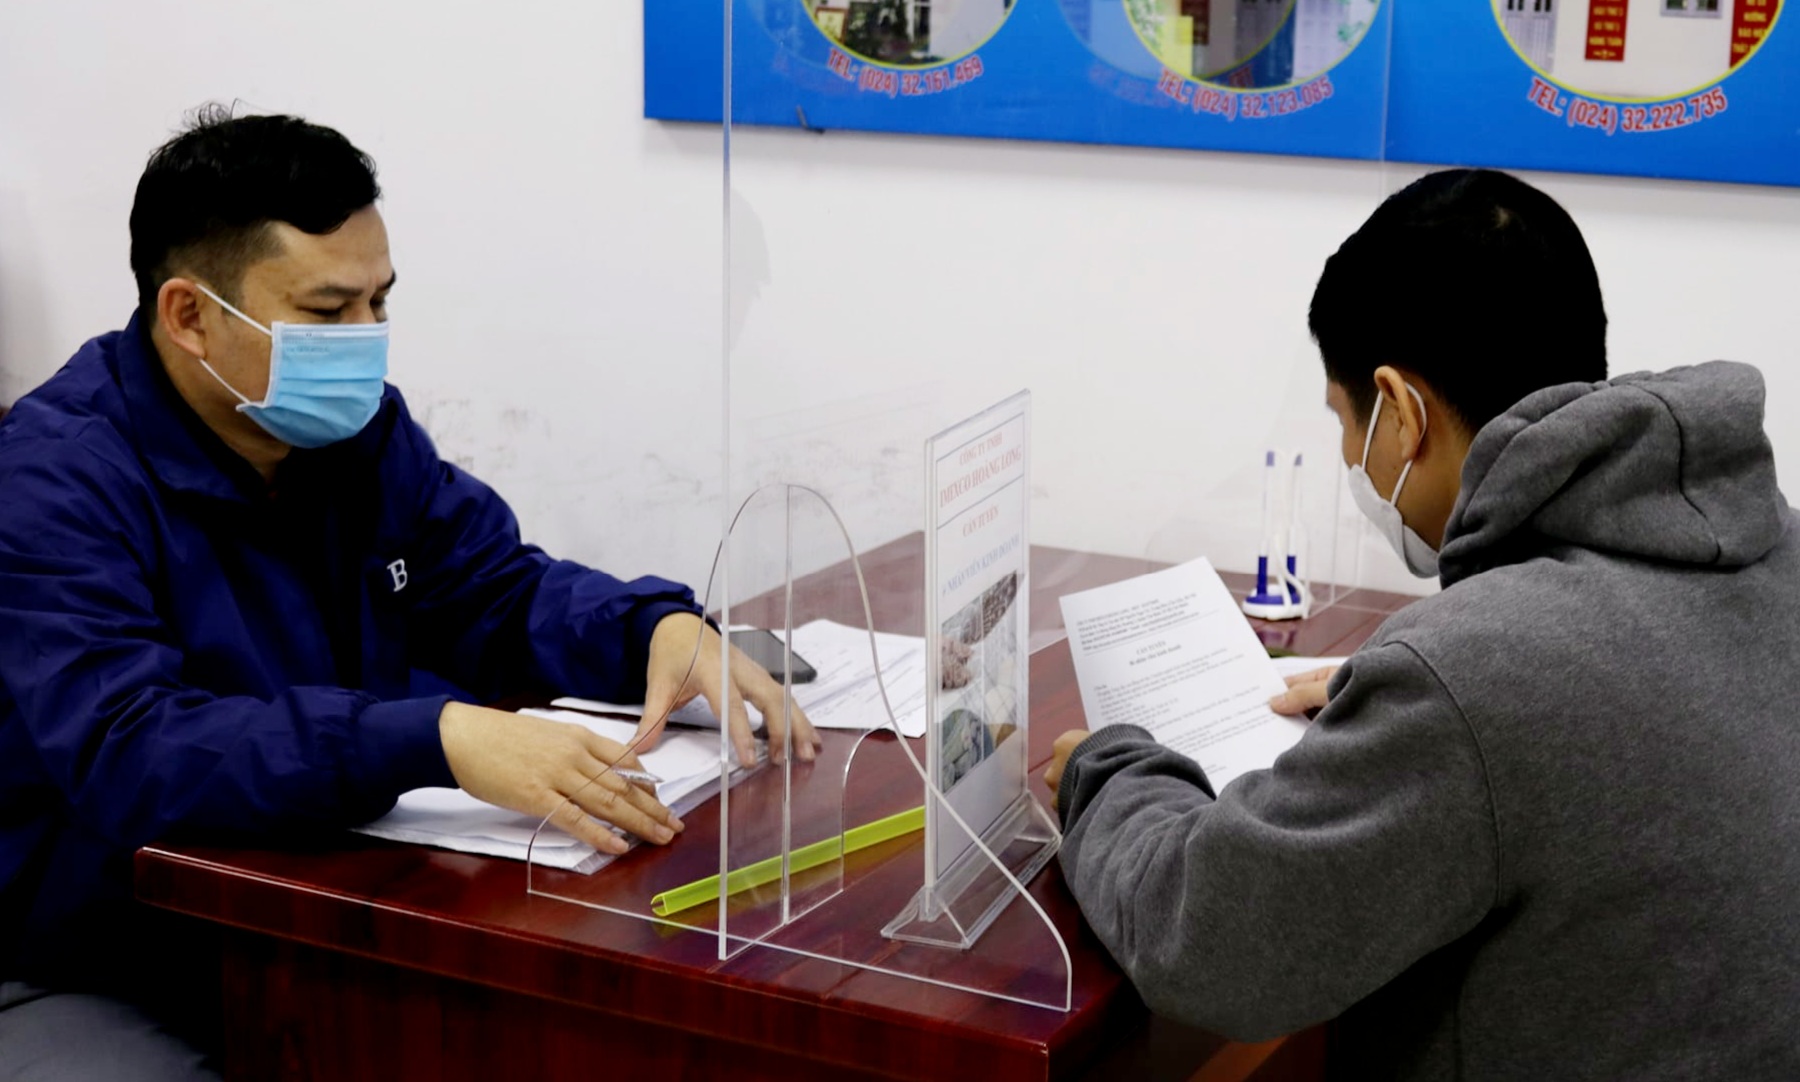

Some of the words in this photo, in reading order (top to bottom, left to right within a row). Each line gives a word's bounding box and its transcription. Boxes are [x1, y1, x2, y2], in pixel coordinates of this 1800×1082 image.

[828, 48, 858, 82] TEL:
[859, 65, 899, 99] (024)
[1158, 67, 1192, 104] TEL:
[1192, 84, 1238, 121] (024)
[1528, 76, 1567, 116] TEL:
[1567, 96, 1618, 136] (024)
[1622, 86, 1728, 132] 32.222.735
[1001, 444, 1022, 471] LONG
[386, 558, 408, 592] B
